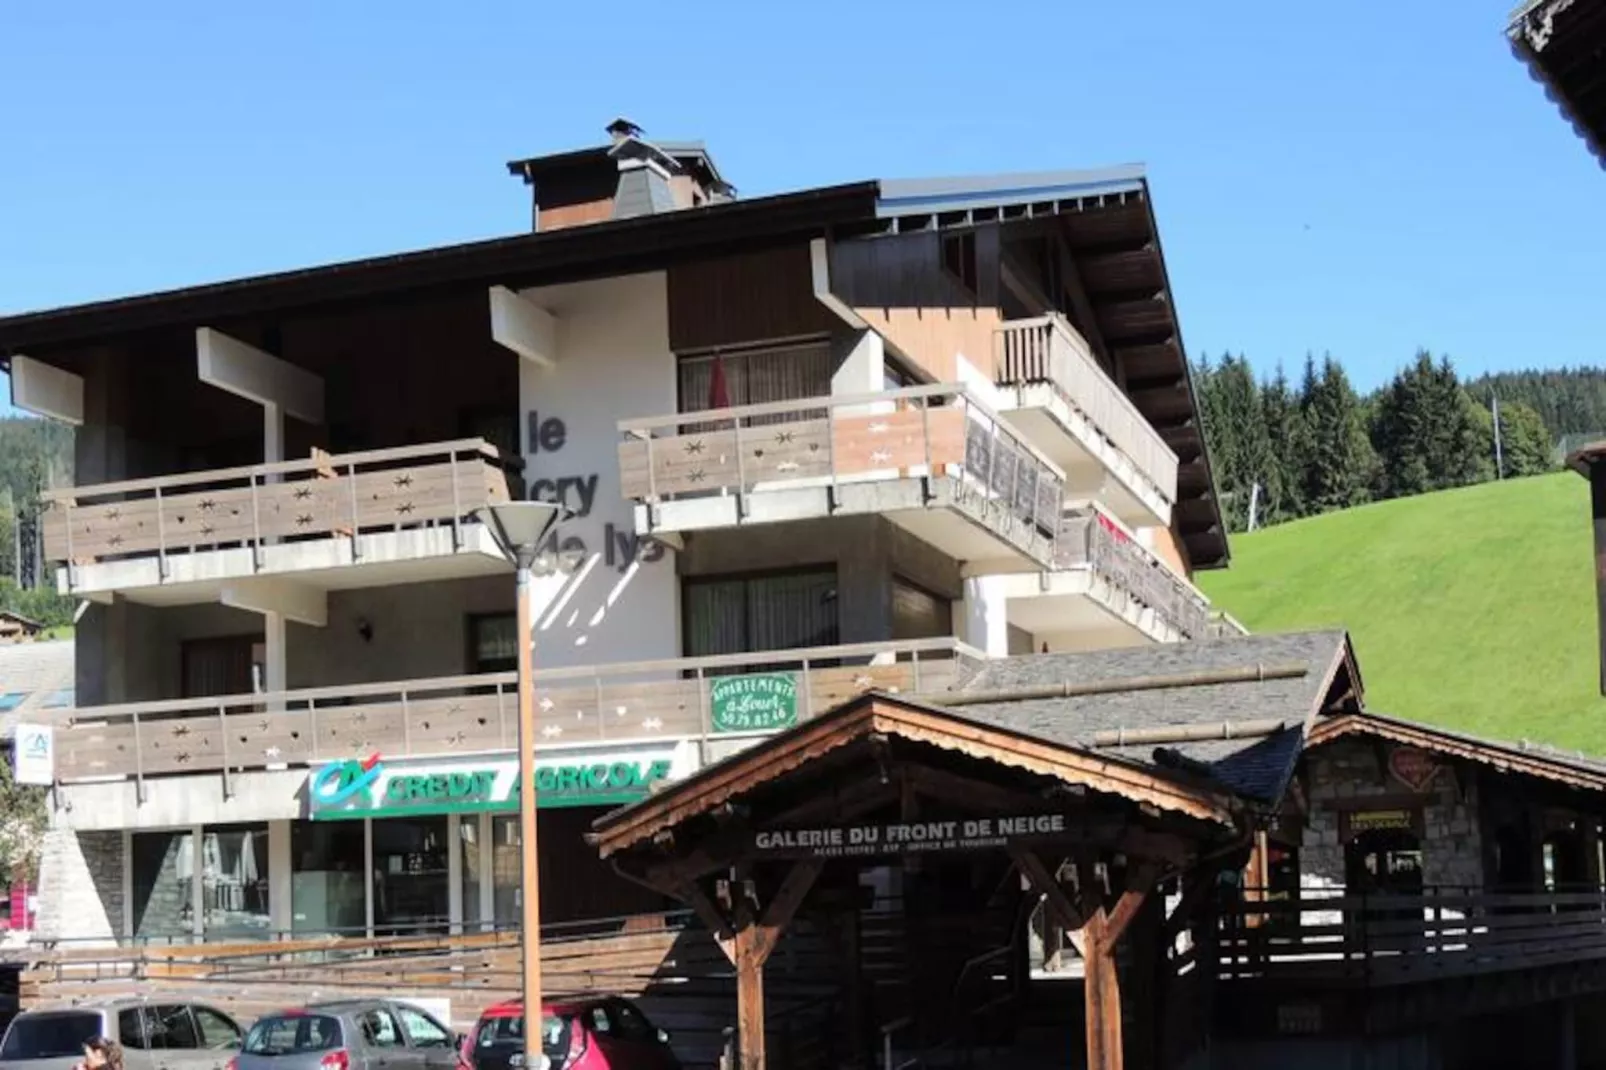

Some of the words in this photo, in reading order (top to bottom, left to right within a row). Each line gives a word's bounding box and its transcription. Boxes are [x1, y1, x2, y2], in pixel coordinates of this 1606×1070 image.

[528, 410, 567, 453] le
[530, 473, 599, 518] cry
[532, 529, 588, 577] de
[604, 523, 665, 573] lys
[713, 679, 793, 701] APPARTEMENTS
[756, 829, 842, 849] GALERIE
[850, 826, 879, 844] DU
[887, 821, 957, 843] FRONT
[963, 819, 992, 838] DE
[998, 814, 1065, 835] NEIGE
